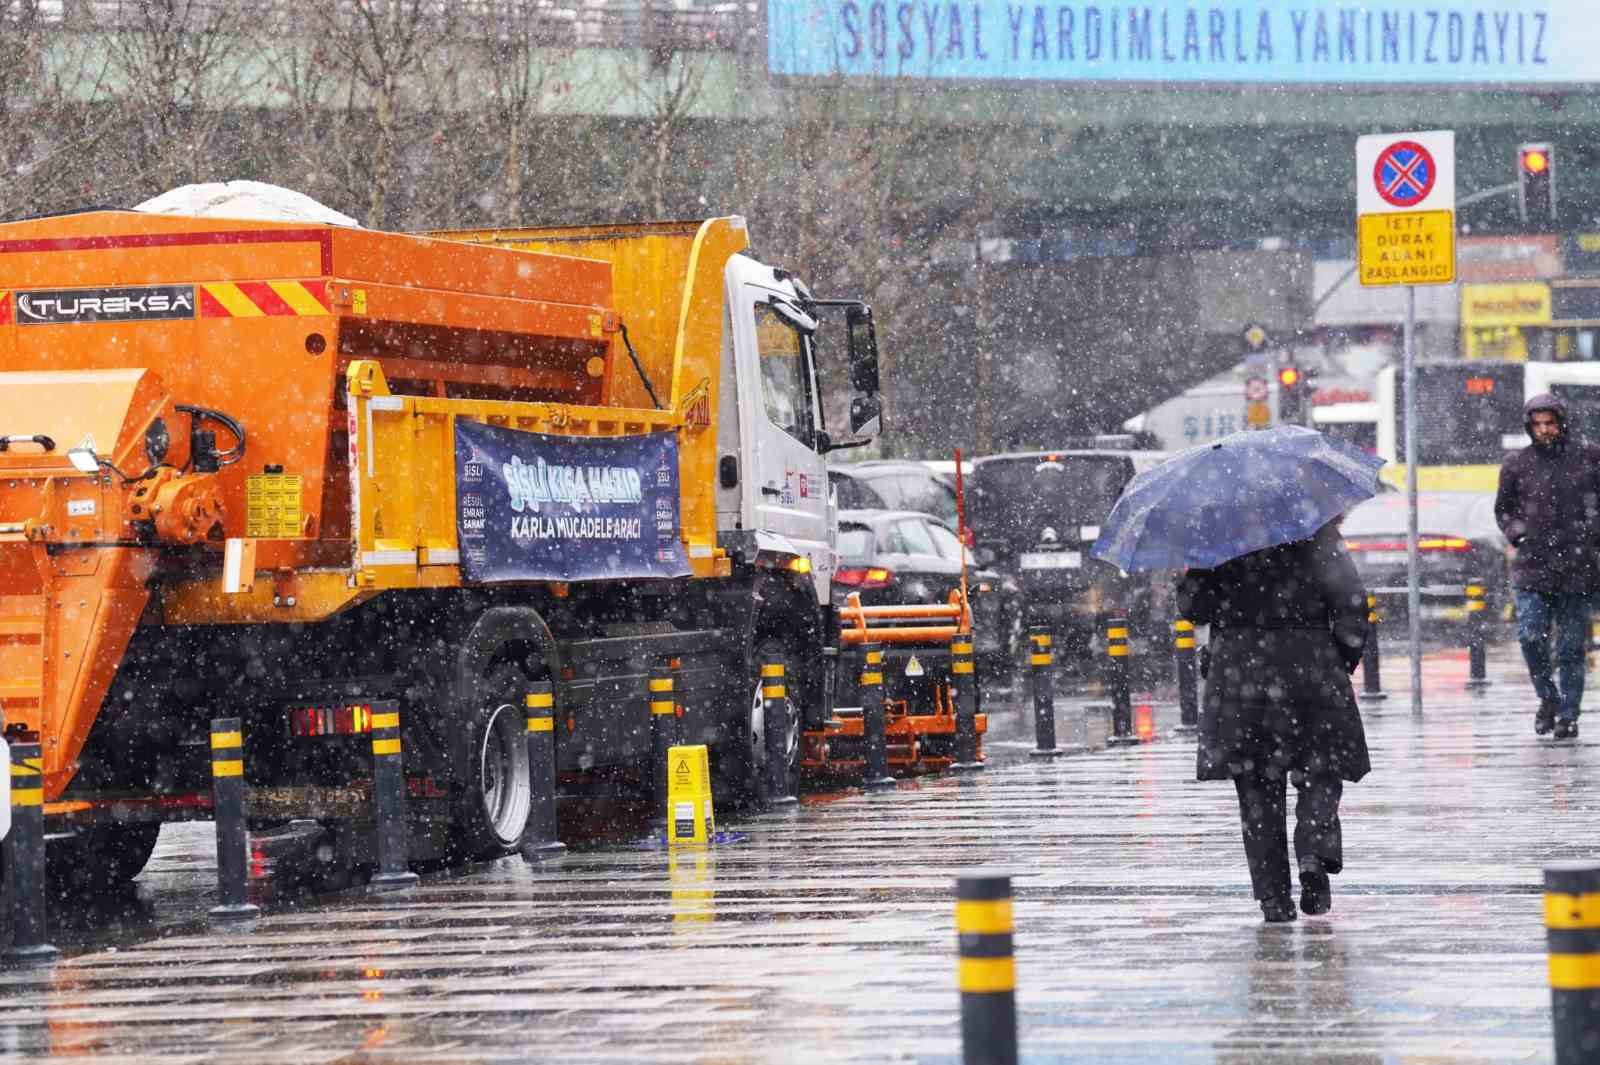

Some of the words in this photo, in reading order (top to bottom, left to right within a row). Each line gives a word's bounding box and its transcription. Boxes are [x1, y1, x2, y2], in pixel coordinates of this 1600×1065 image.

[838, 1, 988, 61] SOSYAL
[1006, 5, 1274, 63] YARDIMLARLA
[1289, 9, 1548, 65] YANINIZDAYIZ
[1376, 233, 1434, 247] DURAK
[1380, 249, 1434, 262] ALANI
[31, 295, 192, 316] TUREKSA
[511, 516, 556, 539] KARLA
[554, 511, 613, 539] MÜCADELE
